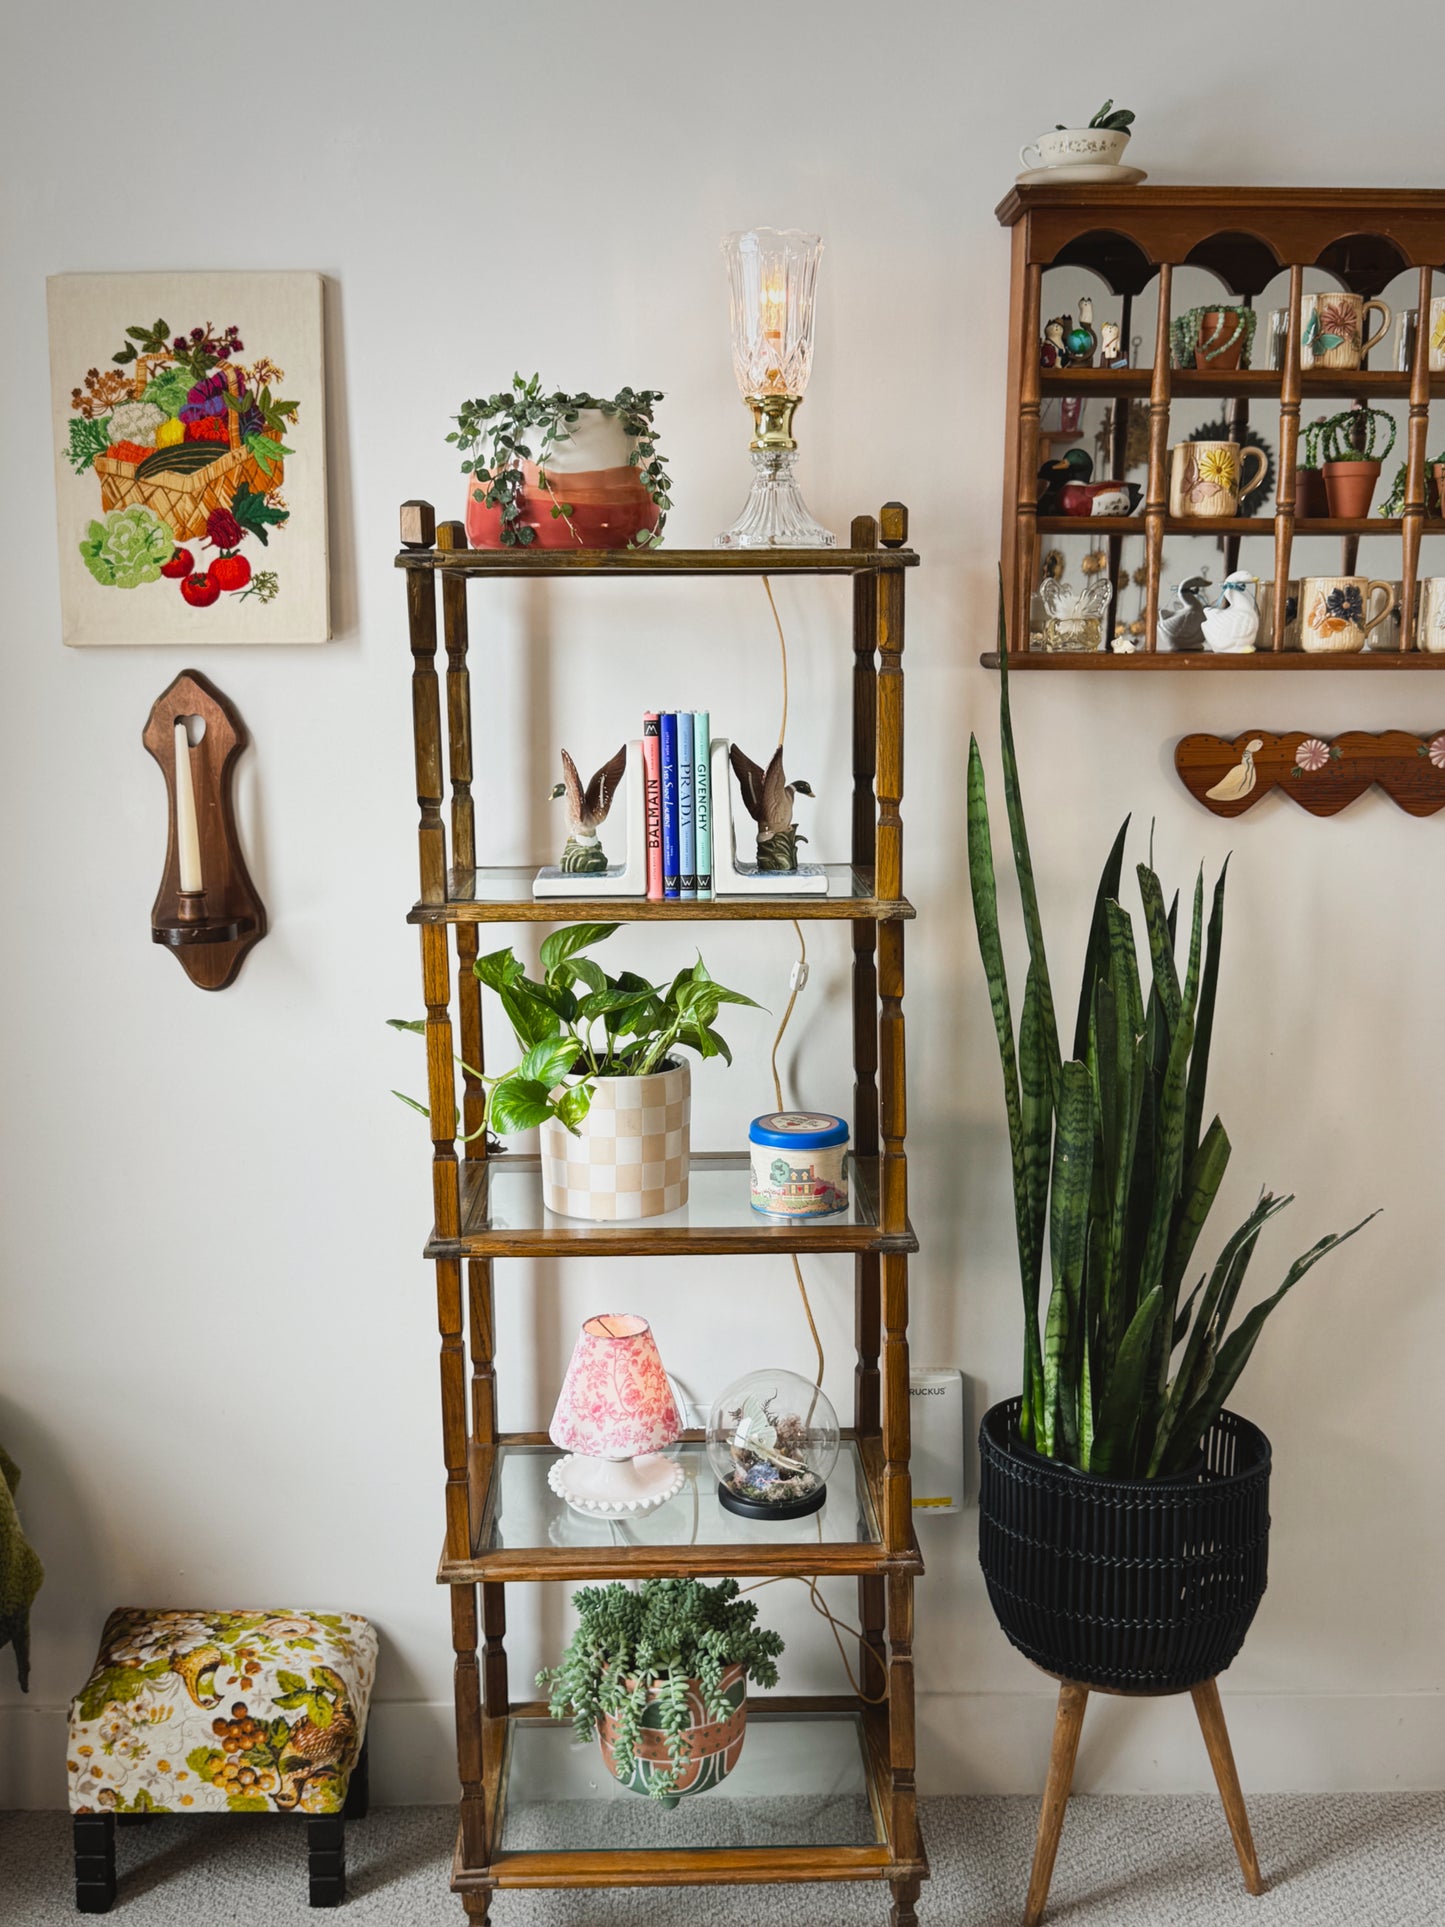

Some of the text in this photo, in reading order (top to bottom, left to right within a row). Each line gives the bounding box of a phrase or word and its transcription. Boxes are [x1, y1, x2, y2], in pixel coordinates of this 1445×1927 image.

[648, 780, 660, 848] BALMAIN
[681, 764, 691, 827] PRADA
[697, 764, 707, 832] GIVENCHY
[909, 1388, 945, 1396] RUCKUS
